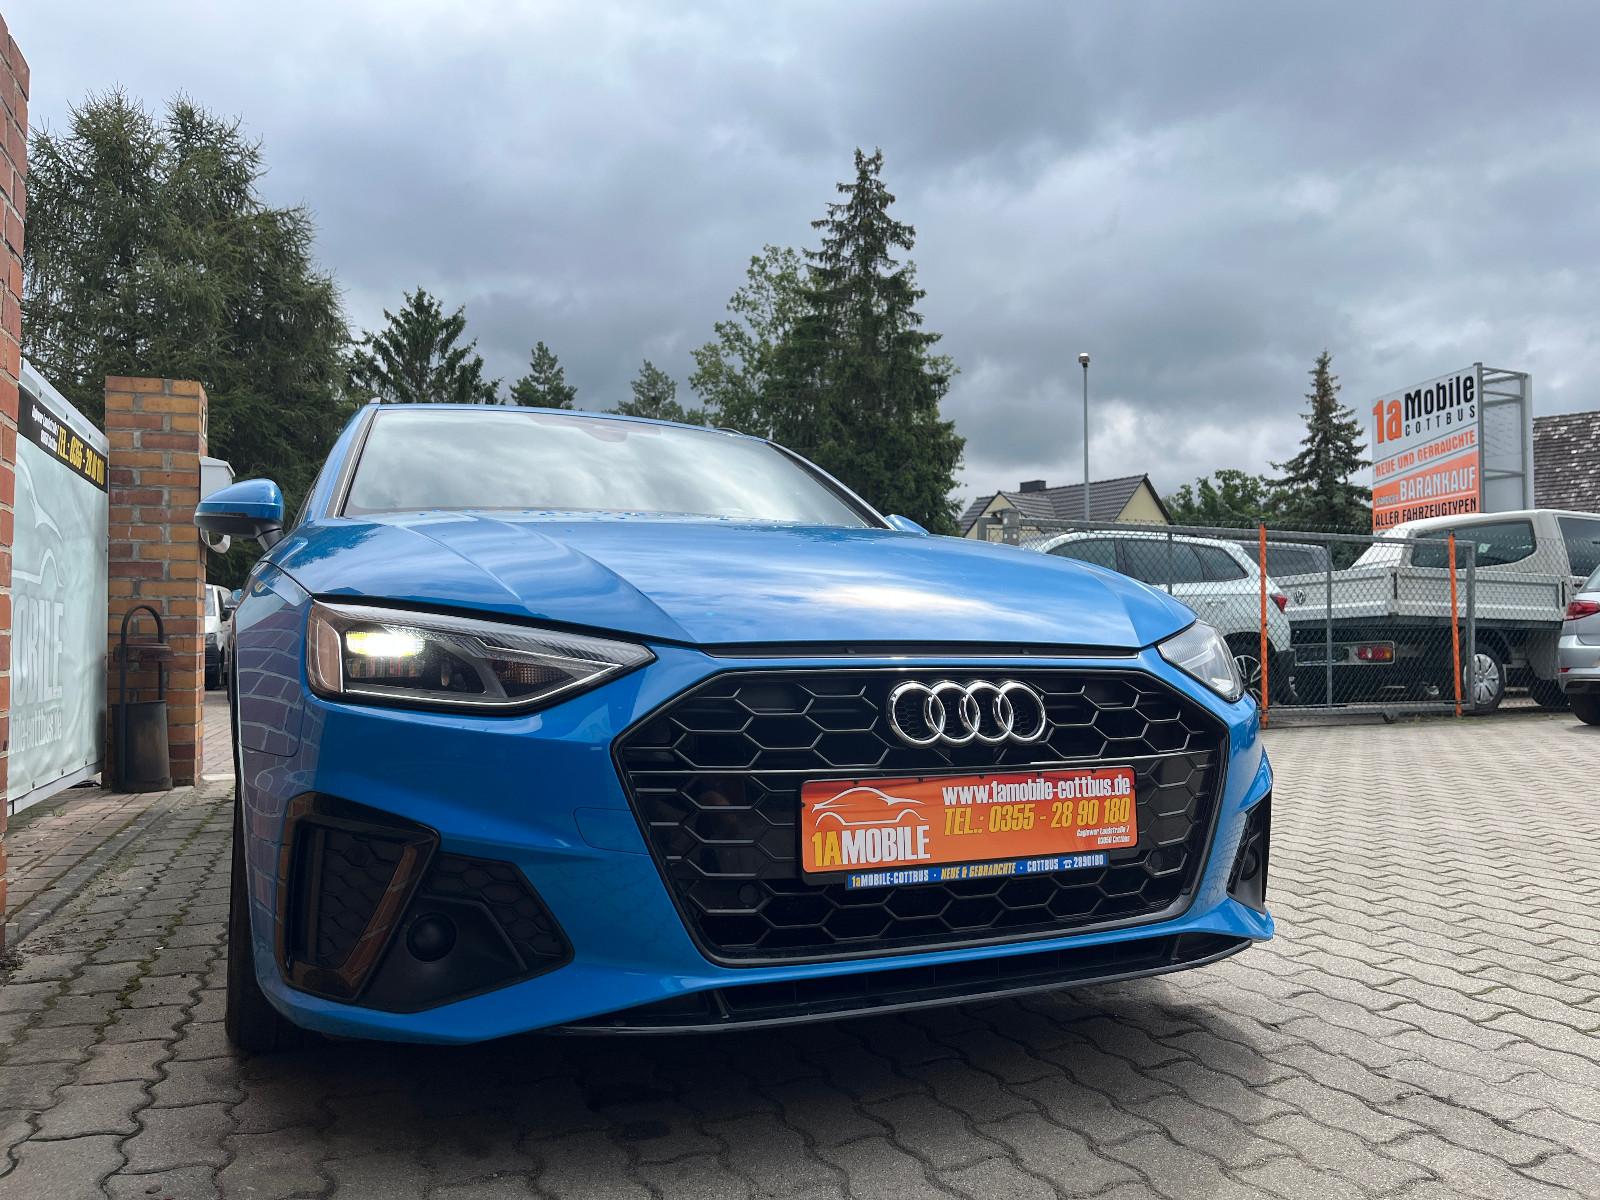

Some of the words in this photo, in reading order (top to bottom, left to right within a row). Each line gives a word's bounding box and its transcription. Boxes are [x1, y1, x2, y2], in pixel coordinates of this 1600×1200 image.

[1372, 399, 1402, 444] 1a
[1404, 375, 1475, 421] Mobile
[1405, 405, 1476, 437] COTTBUS
[1375, 458, 1396, 477] NEUE
[1397, 452, 1415, 469] UND
[1417, 430, 1476, 461] GEBRAUCHTE
[1400, 465, 1476, 501] BARANKAUF
[1375, 510, 1400, 527] ALLER
[1402, 497, 1477, 522] FAHRZEUGTYPEN
[12, 595, 64, 707] OBILE
[942, 774, 1131, 806] www.1amobile-cottbus.de
[988, 804, 1036, 833] 0355
[1051, 801, 1073, 829] 28
[1076, 799, 1100, 826] 90
[1104, 798, 1131, 824] 180
[812, 825, 931, 867] 1AMOBILE
[851, 869, 929, 888] 1aMOBILE-COTTBUS
[940, 866, 960, 880] NEUE
[969, 862, 1016, 878] GEBRAUCHTE
[1026, 858, 1059, 872] COTTBUS
[1073, 854, 1104, 868] 2890180
